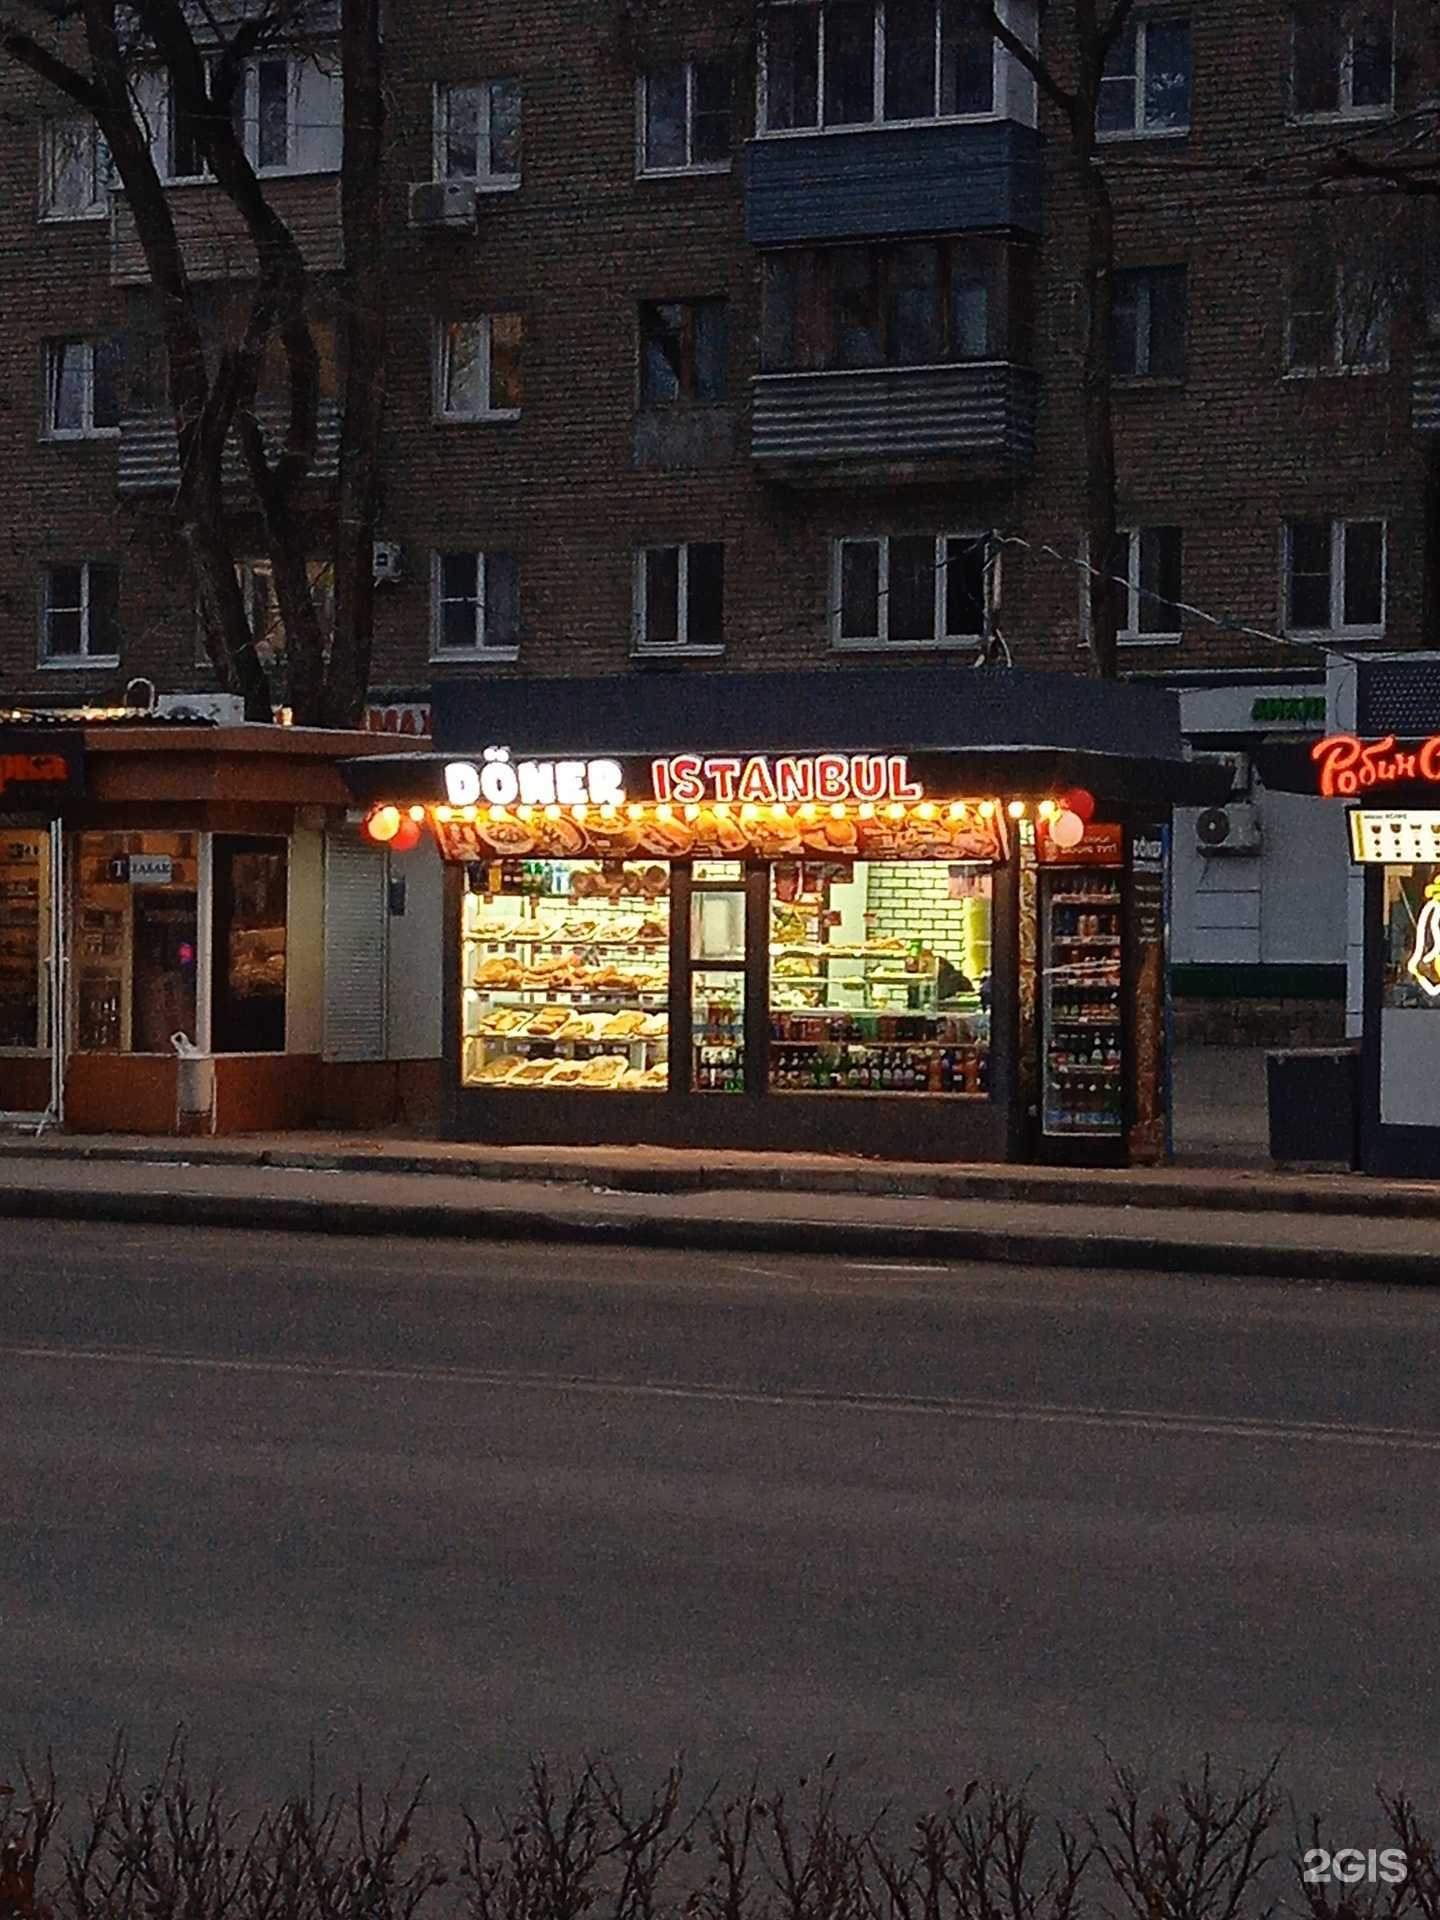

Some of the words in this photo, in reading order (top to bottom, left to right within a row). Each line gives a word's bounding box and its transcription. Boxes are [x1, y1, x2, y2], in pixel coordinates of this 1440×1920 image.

[444, 746, 625, 806] DÖNER
[651, 754, 923, 803] ISTANBUL
[1312, 735, 1417, 798] Робин
